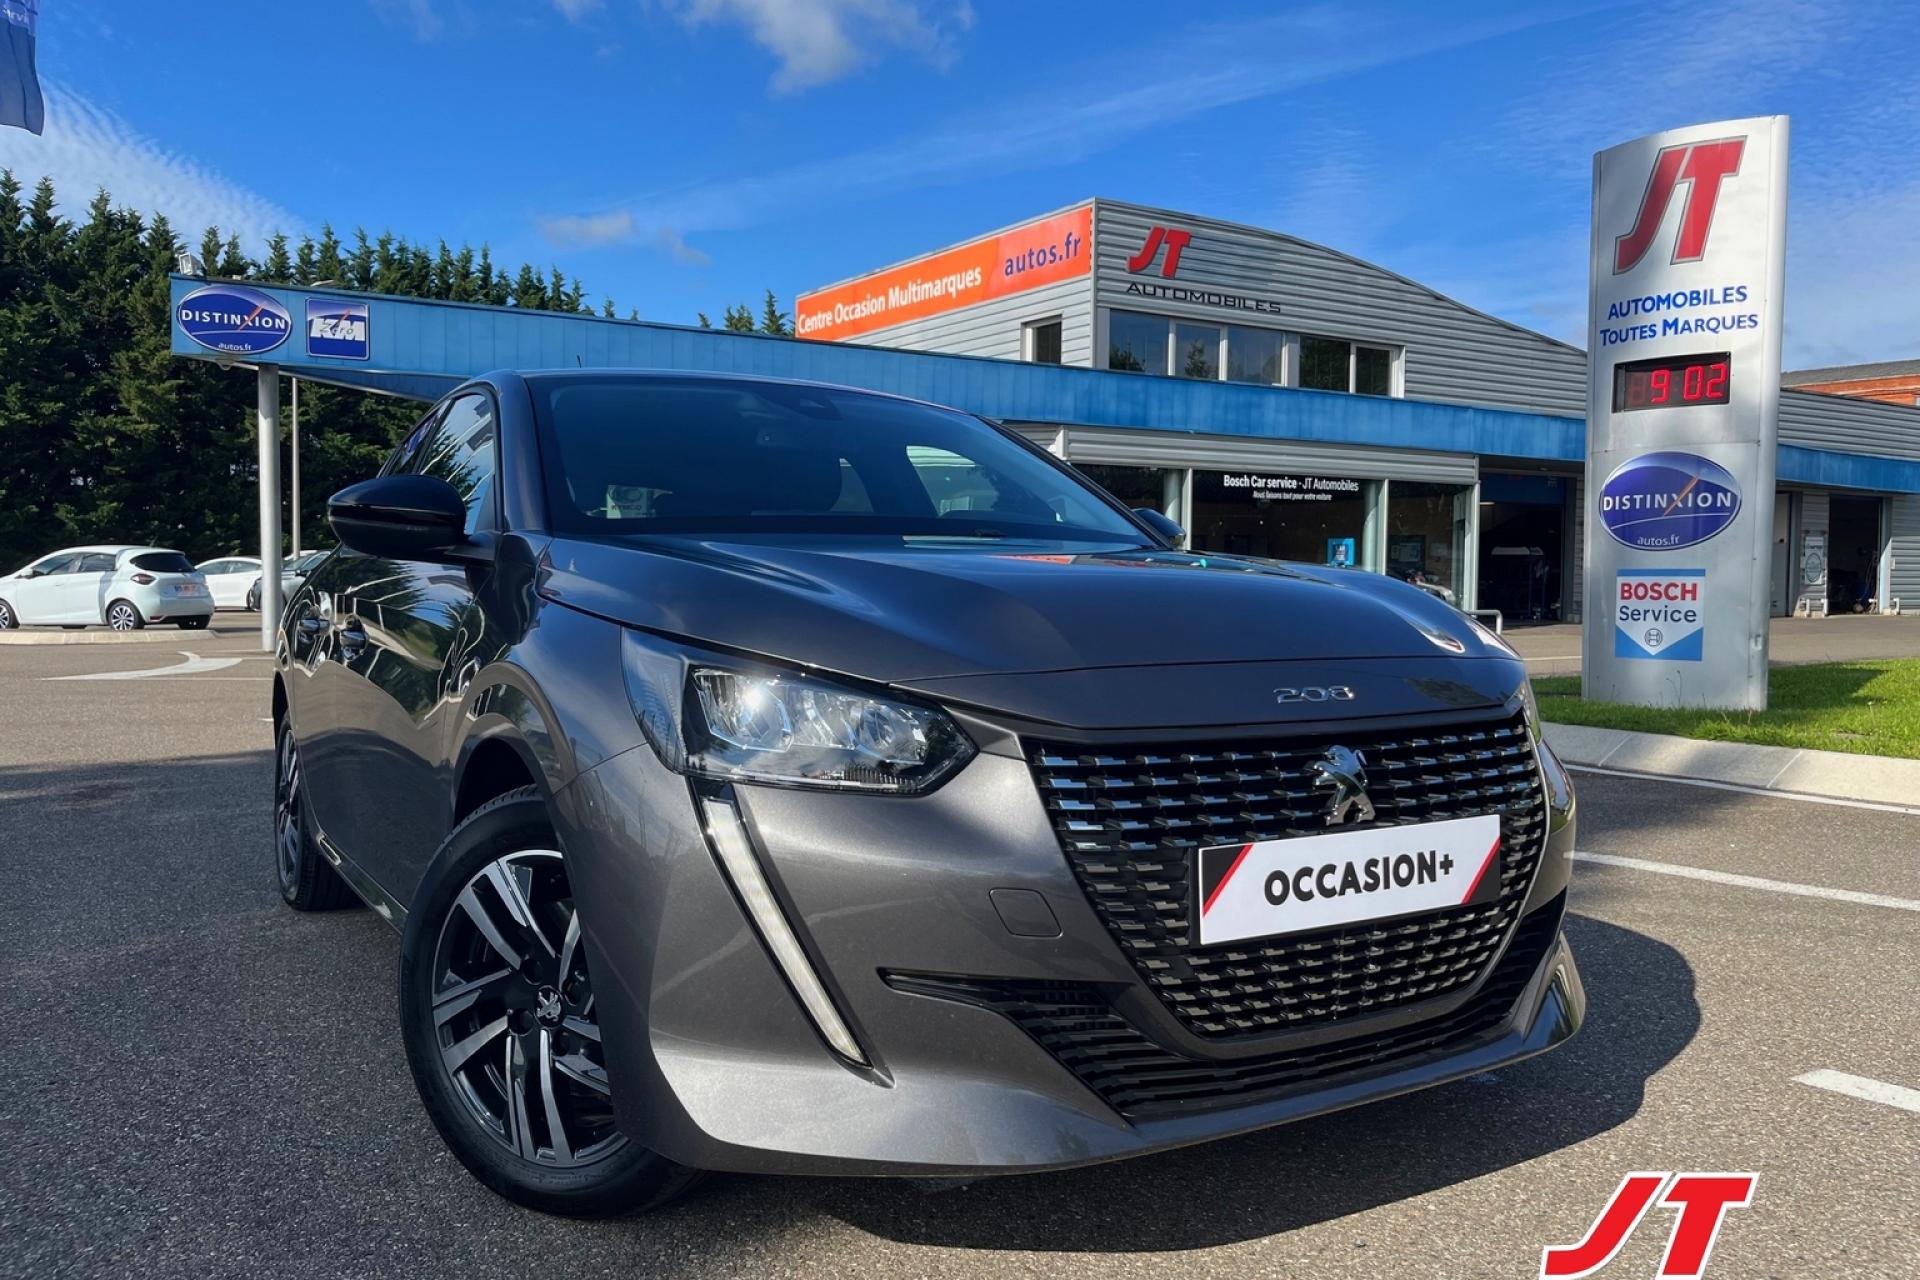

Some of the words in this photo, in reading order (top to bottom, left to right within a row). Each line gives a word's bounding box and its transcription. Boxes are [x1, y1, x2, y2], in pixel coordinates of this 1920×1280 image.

[1612, 135, 1748, 276] JT
[1126, 225, 1192, 279] JT
[798, 310, 833, 334] Centre
[834, 295, 886, 323] Occasion
[888, 266, 982, 310] Multimarques
[1004, 232, 1081, 276] autos.fr
[1126, 282, 1281, 314] AUTOMOBILES
[1608, 285, 1748, 321] AUTOMOBILES
[181, 309, 286, 330] DISTINXION
[1600, 323, 1657, 346] TOUTES
[1662, 313, 1759, 337] MARQUES
[1223, 474, 1250, 487] Bosch
[1251, 475, 1265, 488] Car
[1266, 476, 1297, 489] service
[1302, 478, 1313, 490] JT
[1313, 478, 1360, 491] Automobiles
[1603, 491, 1732, 511] DISTINXION
[1637, 534, 1680, 546] autos.fr
[1620, 582, 1697, 601] BOSCH
[1619, 605, 1697, 623] Service
[1273, 685, 1355, 703] 208
[1263, 850, 1454, 906] OCCASION+
